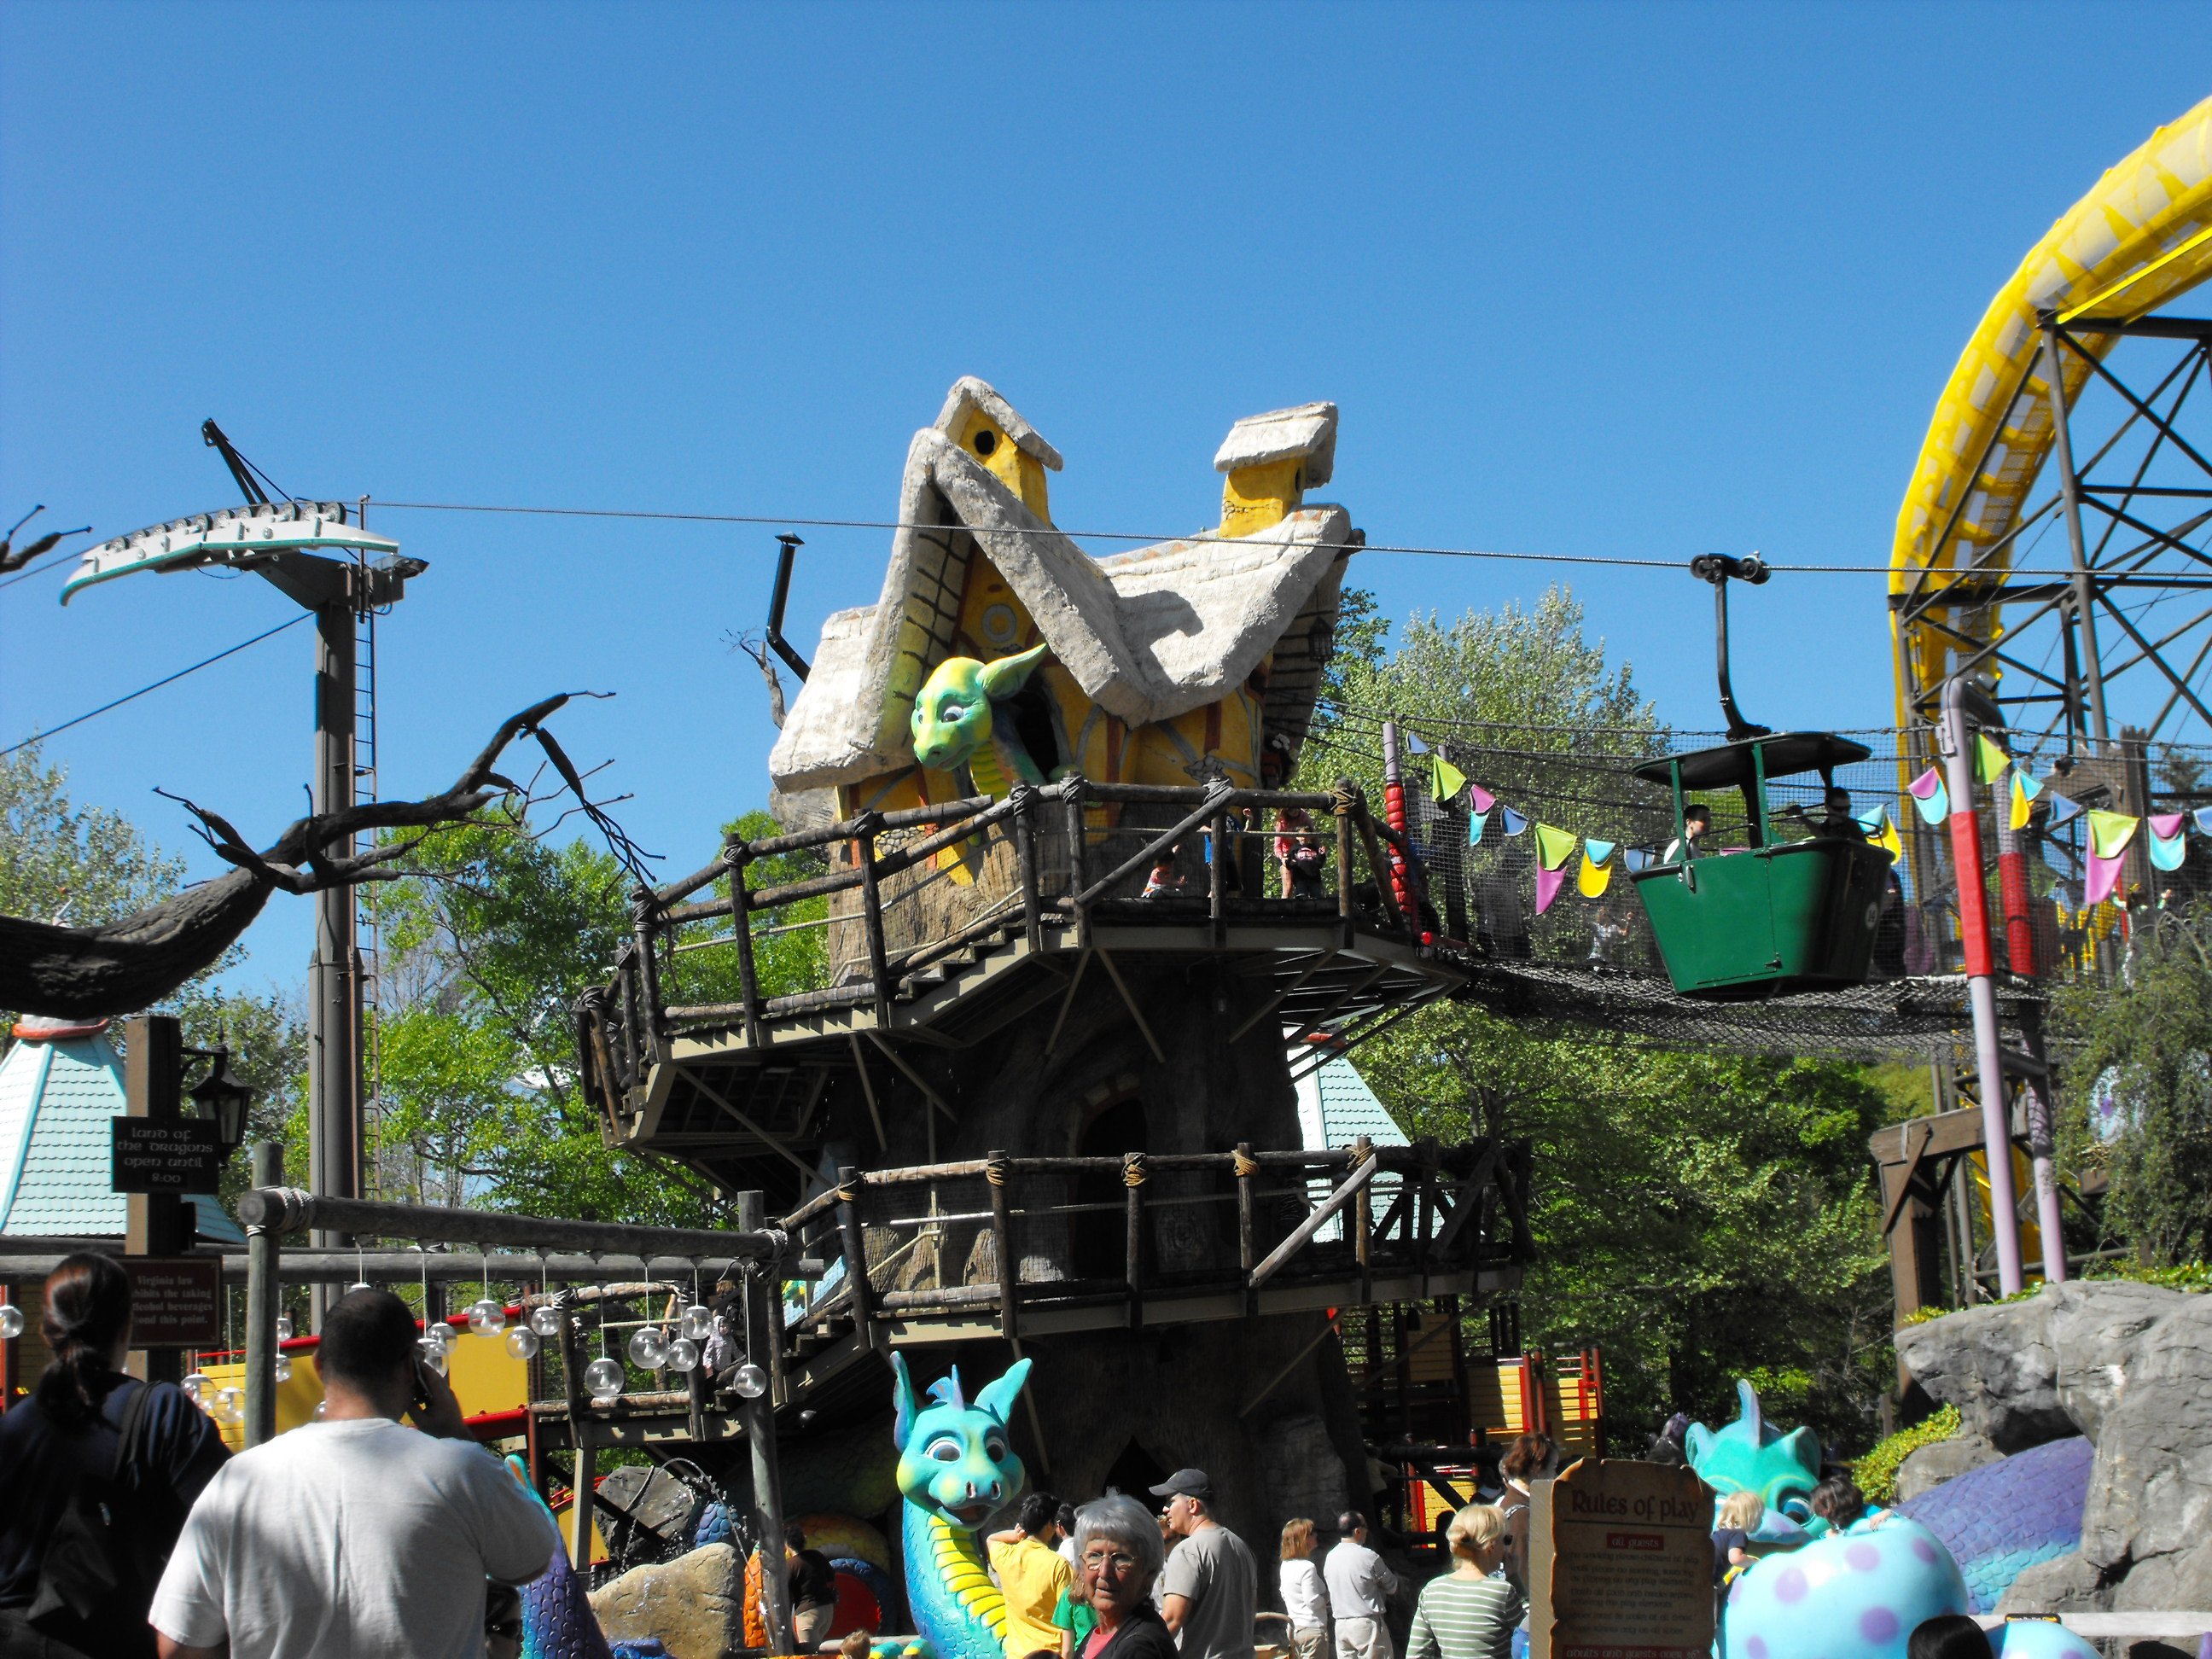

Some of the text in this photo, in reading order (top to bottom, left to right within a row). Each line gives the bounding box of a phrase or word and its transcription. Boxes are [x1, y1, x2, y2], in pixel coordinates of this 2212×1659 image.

[173, 1129, 192, 1142] of
[117, 1139, 143, 1151] the
[123, 1156, 204, 1168] open until
[151, 1173, 181, 1183] 8:00
[137, 1275, 194, 1288] Virginia law
[163, 1289, 178, 1298] the
[182, 1289, 212, 1300] taking
[166, 1301, 213, 1313] beverages
[159, 1314, 178, 1324] this
[181, 1314, 208, 1326] point.
[1571, 1489, 1699, 1523] Rules of play
[1611, 1536, 1659, 1550] all guests
[1566, 1649, 1598, 1658] adults
[1602, 1650, 1622, 1658] and
[1625, 1650, 1657, 1659] guests
